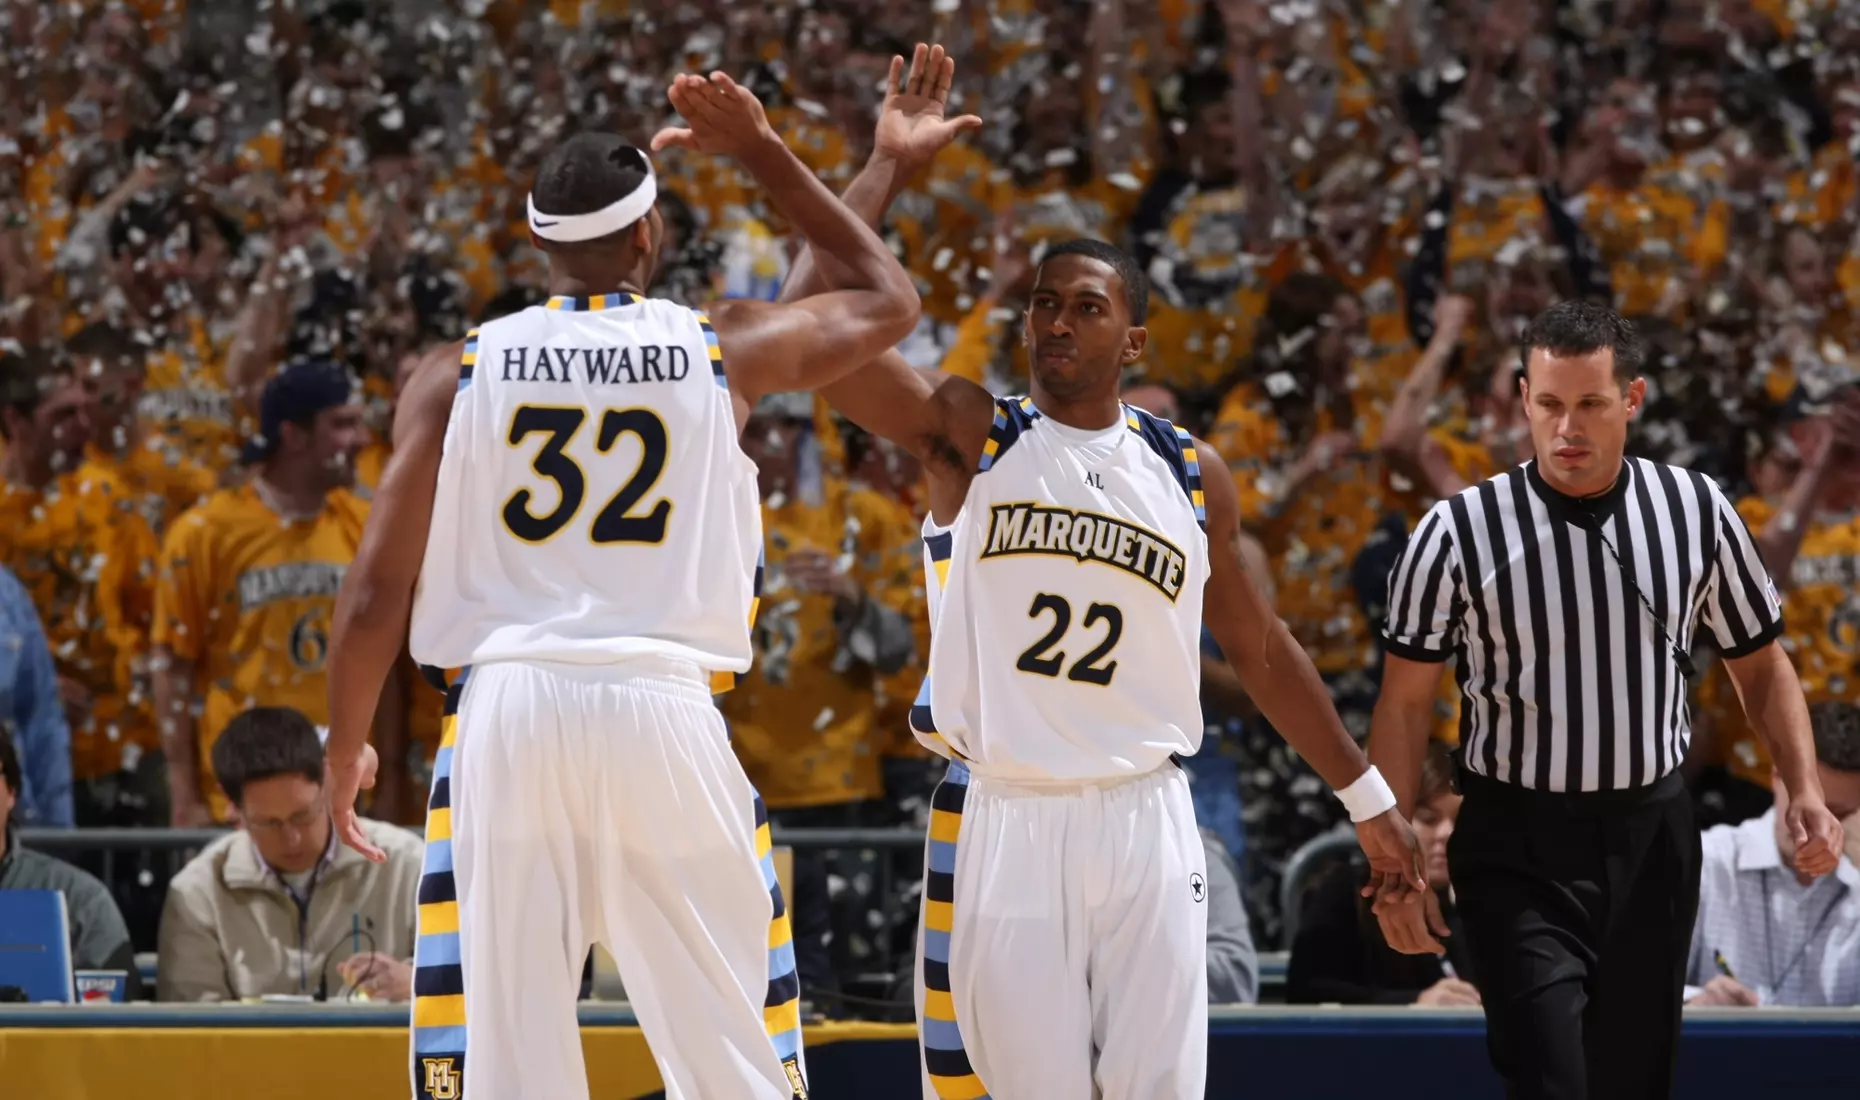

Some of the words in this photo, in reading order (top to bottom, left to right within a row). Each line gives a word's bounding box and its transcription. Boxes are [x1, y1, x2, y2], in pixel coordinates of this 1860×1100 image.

[501, 345, 690, 384] HAYWARD
[501, 403, 674, 546] 32
[1084, 471, 1104, 490] AL
[981, 502, 1187, 602] MARQUETTE
[1016, 592, 1123, 686] 22
[422, 1058, 461, 1100] MU
